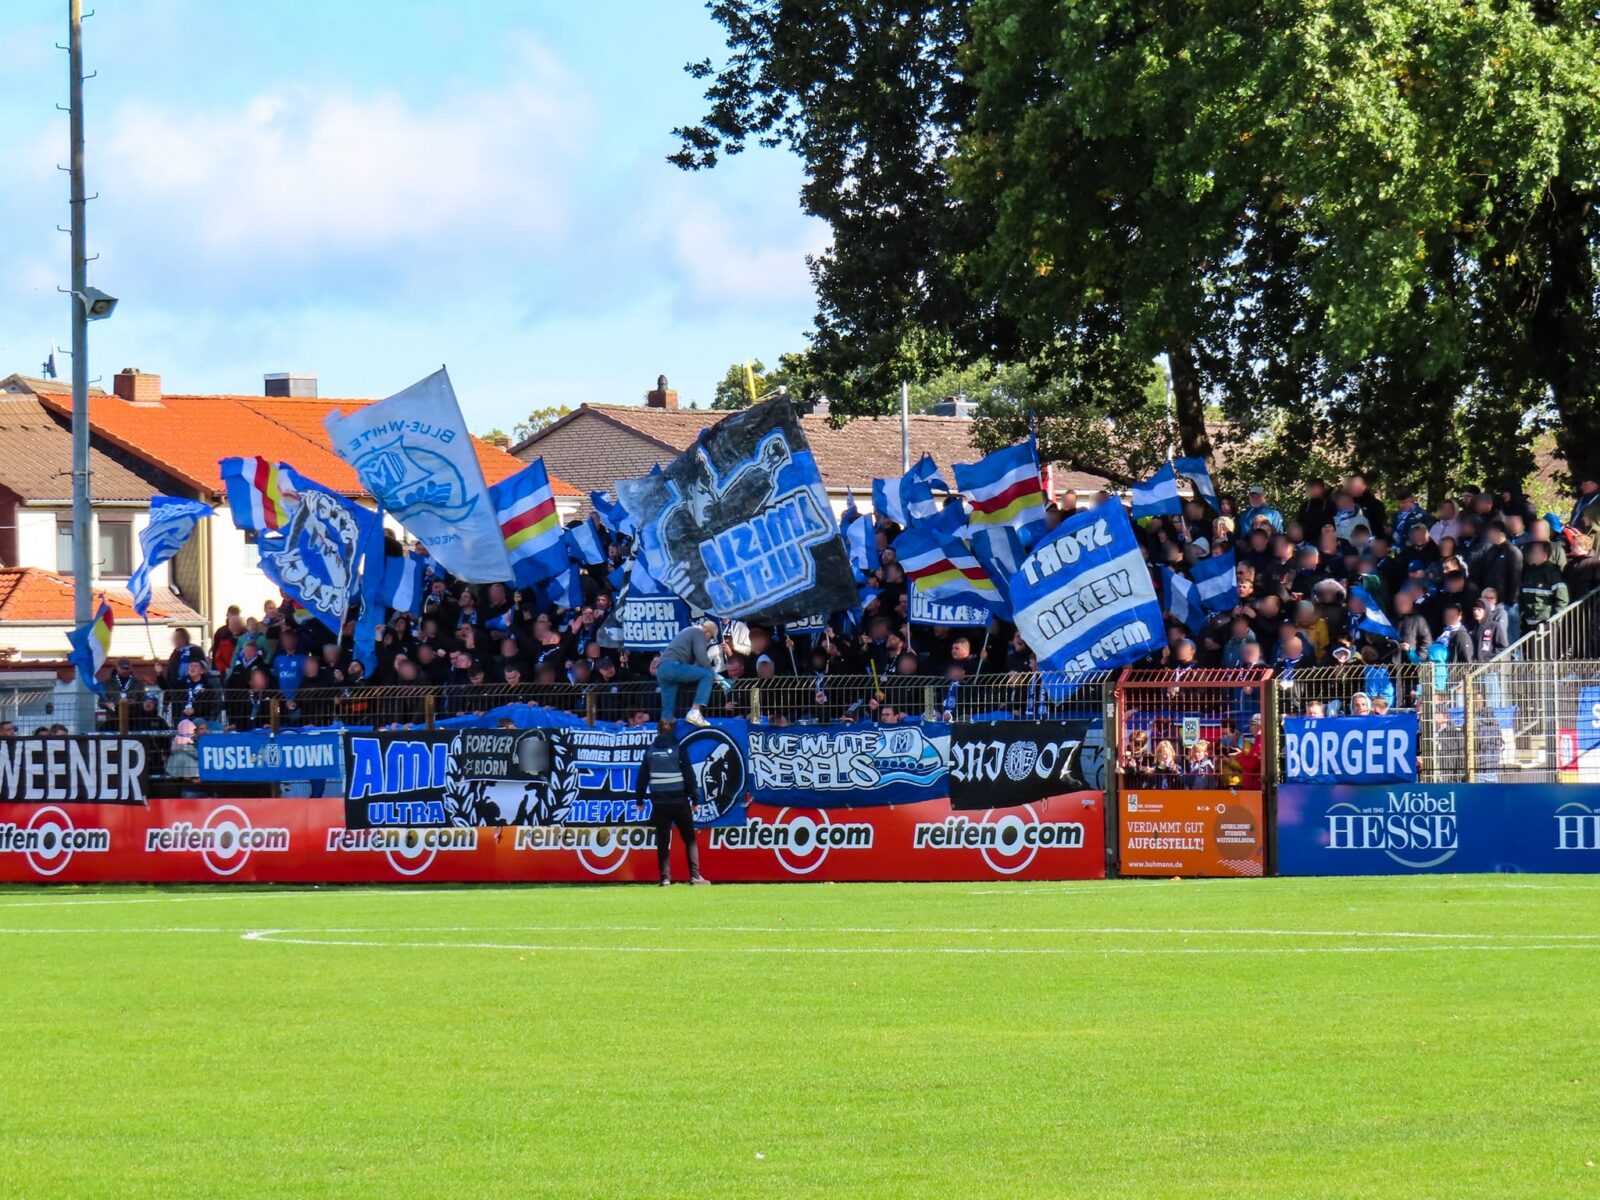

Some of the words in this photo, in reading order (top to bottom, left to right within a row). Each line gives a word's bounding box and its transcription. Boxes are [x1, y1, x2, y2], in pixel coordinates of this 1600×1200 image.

[466, 734, 513, 754] FOREVER
[577, 748, 611, 762] IMMER
[613, 749, 631, 762] BEI
[749, 732, 799, 758] BLUE
[800, 731, 880, 755] WHITE
[1285, 720, 1413, 778] BÖRGER
[203, 746, 254, 770] FUSEL
[282, 744, 334, 769] TOWN
[474, 756, 508, 776] BJÖRN
[750, 753, 881, 789] REBELS
[367, 802, 446, 825] ULTRA
[1387, 791, 1457, 813] Möbel
[147, 824, 287, 849] reifen.com
[916, 819, 1082, 845] reifen.com
[1127, 821, 1181, 833] VERDAMMT
[1184, 821, 1205, 833] GUT
[1324, 814, 1458, 850] HESSE
[1553, 814, 1600, 850] H
[1127, 837, 1205, 850] AUFGESTELLT!
[1128, 860, 1183, 869] www.buhmann.de
